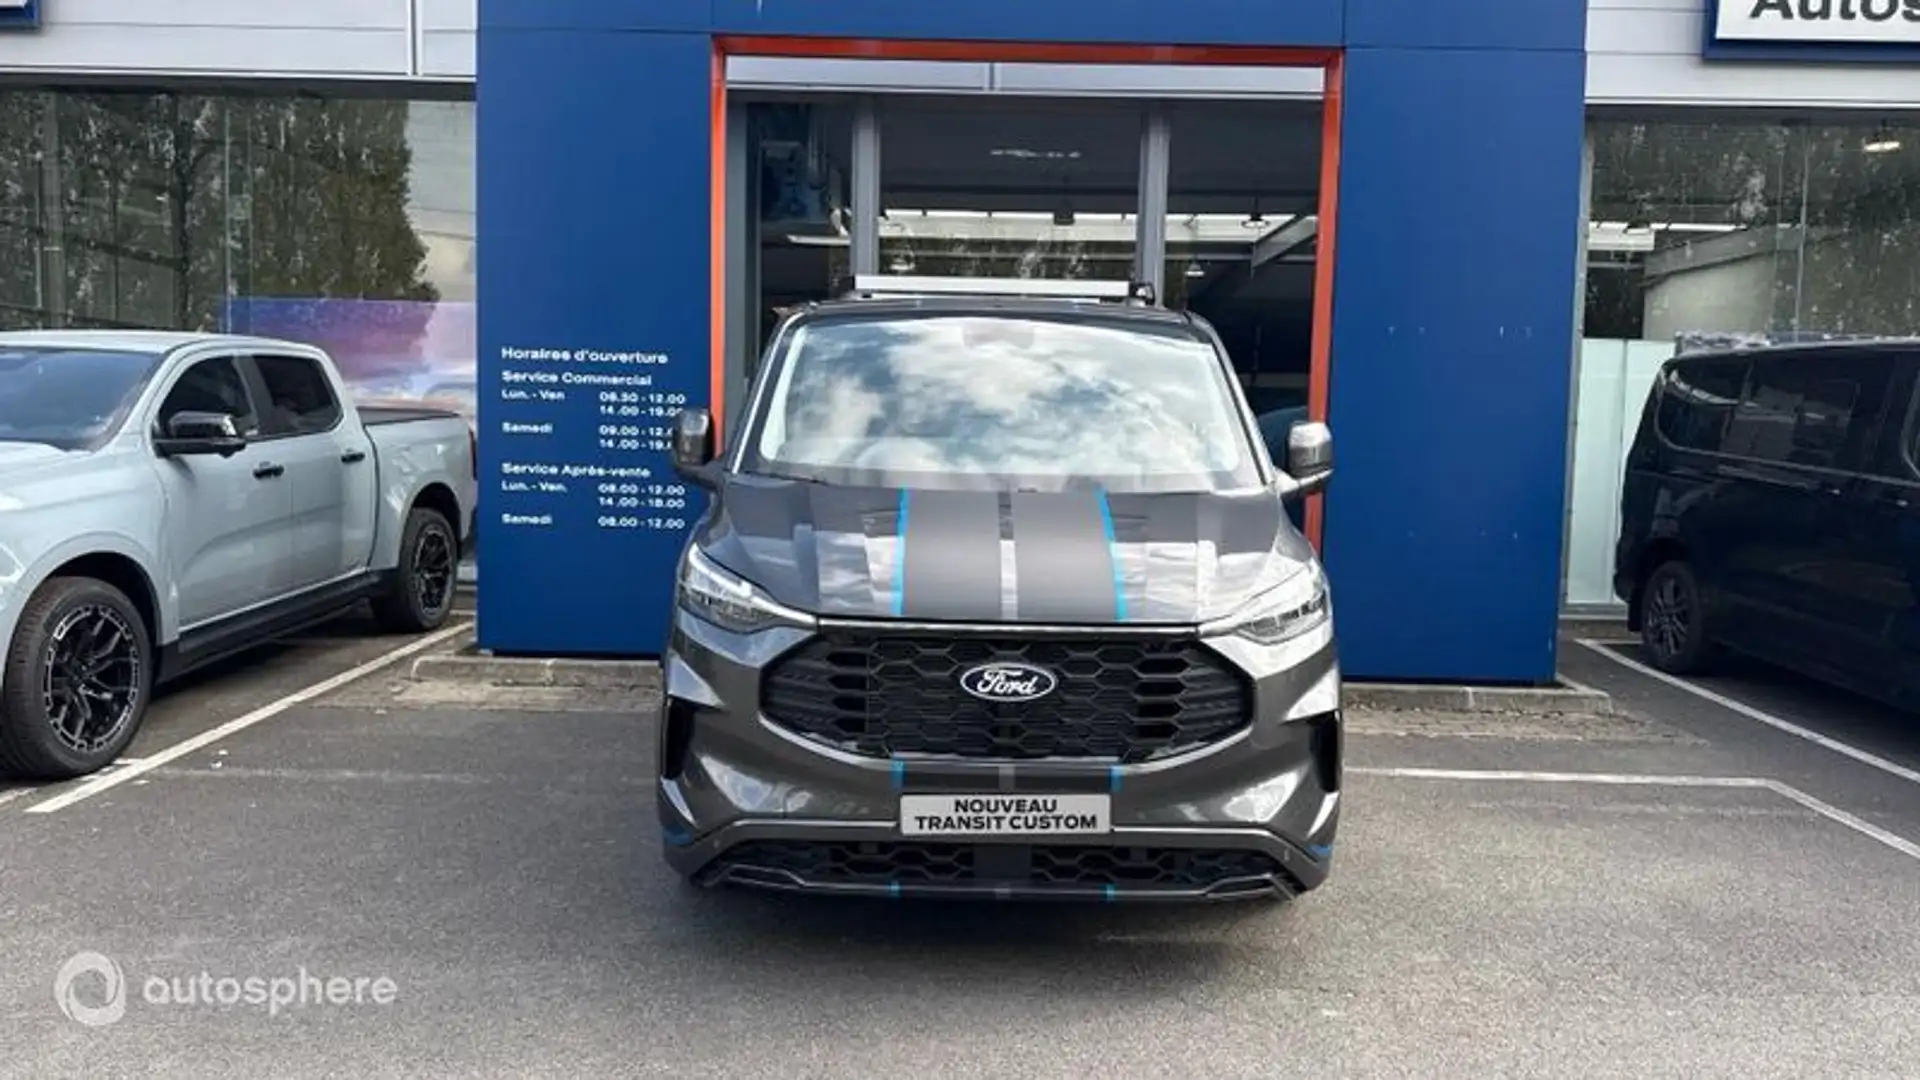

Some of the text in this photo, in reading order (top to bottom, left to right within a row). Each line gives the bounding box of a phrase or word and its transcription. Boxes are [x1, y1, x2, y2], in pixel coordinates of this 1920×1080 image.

[501, 347, 669, 365] Horaires d'ouverture
[501, 370, 653, 386] Service Commercial
[501, 389, 530, 400] Lun.
[502, 421, 554, 434] Samedi
[501, 462, 652, 478] Service Après-vente
[501, 480, 530, 492] Lun.
[502, 513, 553, 526] Samedi
[976, 668, 1039, 694] Ford
[954, 798, 1058, 813] NOUVEAU
[914, 813, 1098, 831] TRANSIT CUSTOM
